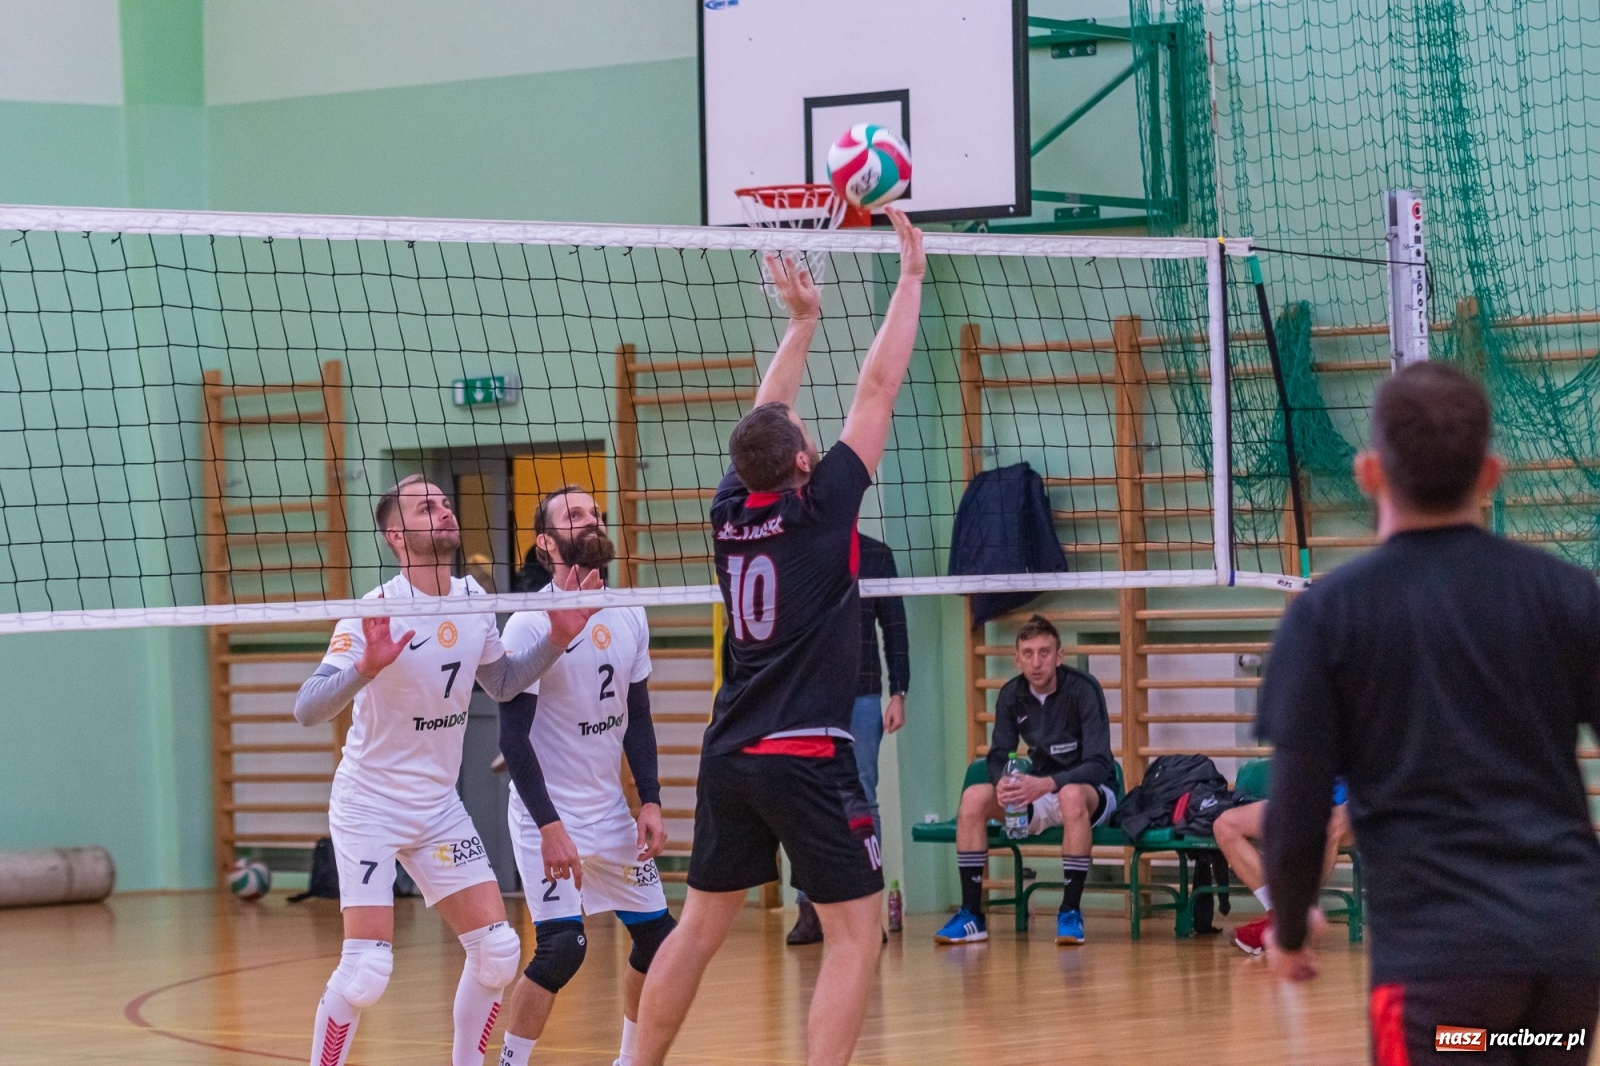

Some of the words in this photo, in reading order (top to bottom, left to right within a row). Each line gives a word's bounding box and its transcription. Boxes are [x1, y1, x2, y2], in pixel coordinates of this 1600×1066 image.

[725, 553, 778, 641] 10
[440, 661, 462, 699] 7
[598, 664, 615, 702] 2
[412, 711, 468, 731] TropiDog
[578, 713, 625, 736] TropDo
[449, 836, 480, 853] ZOO
[864, 834, 882, 871] 10
[359, 860, 379, 885] 7
[541, 877, 560, 903] 2
